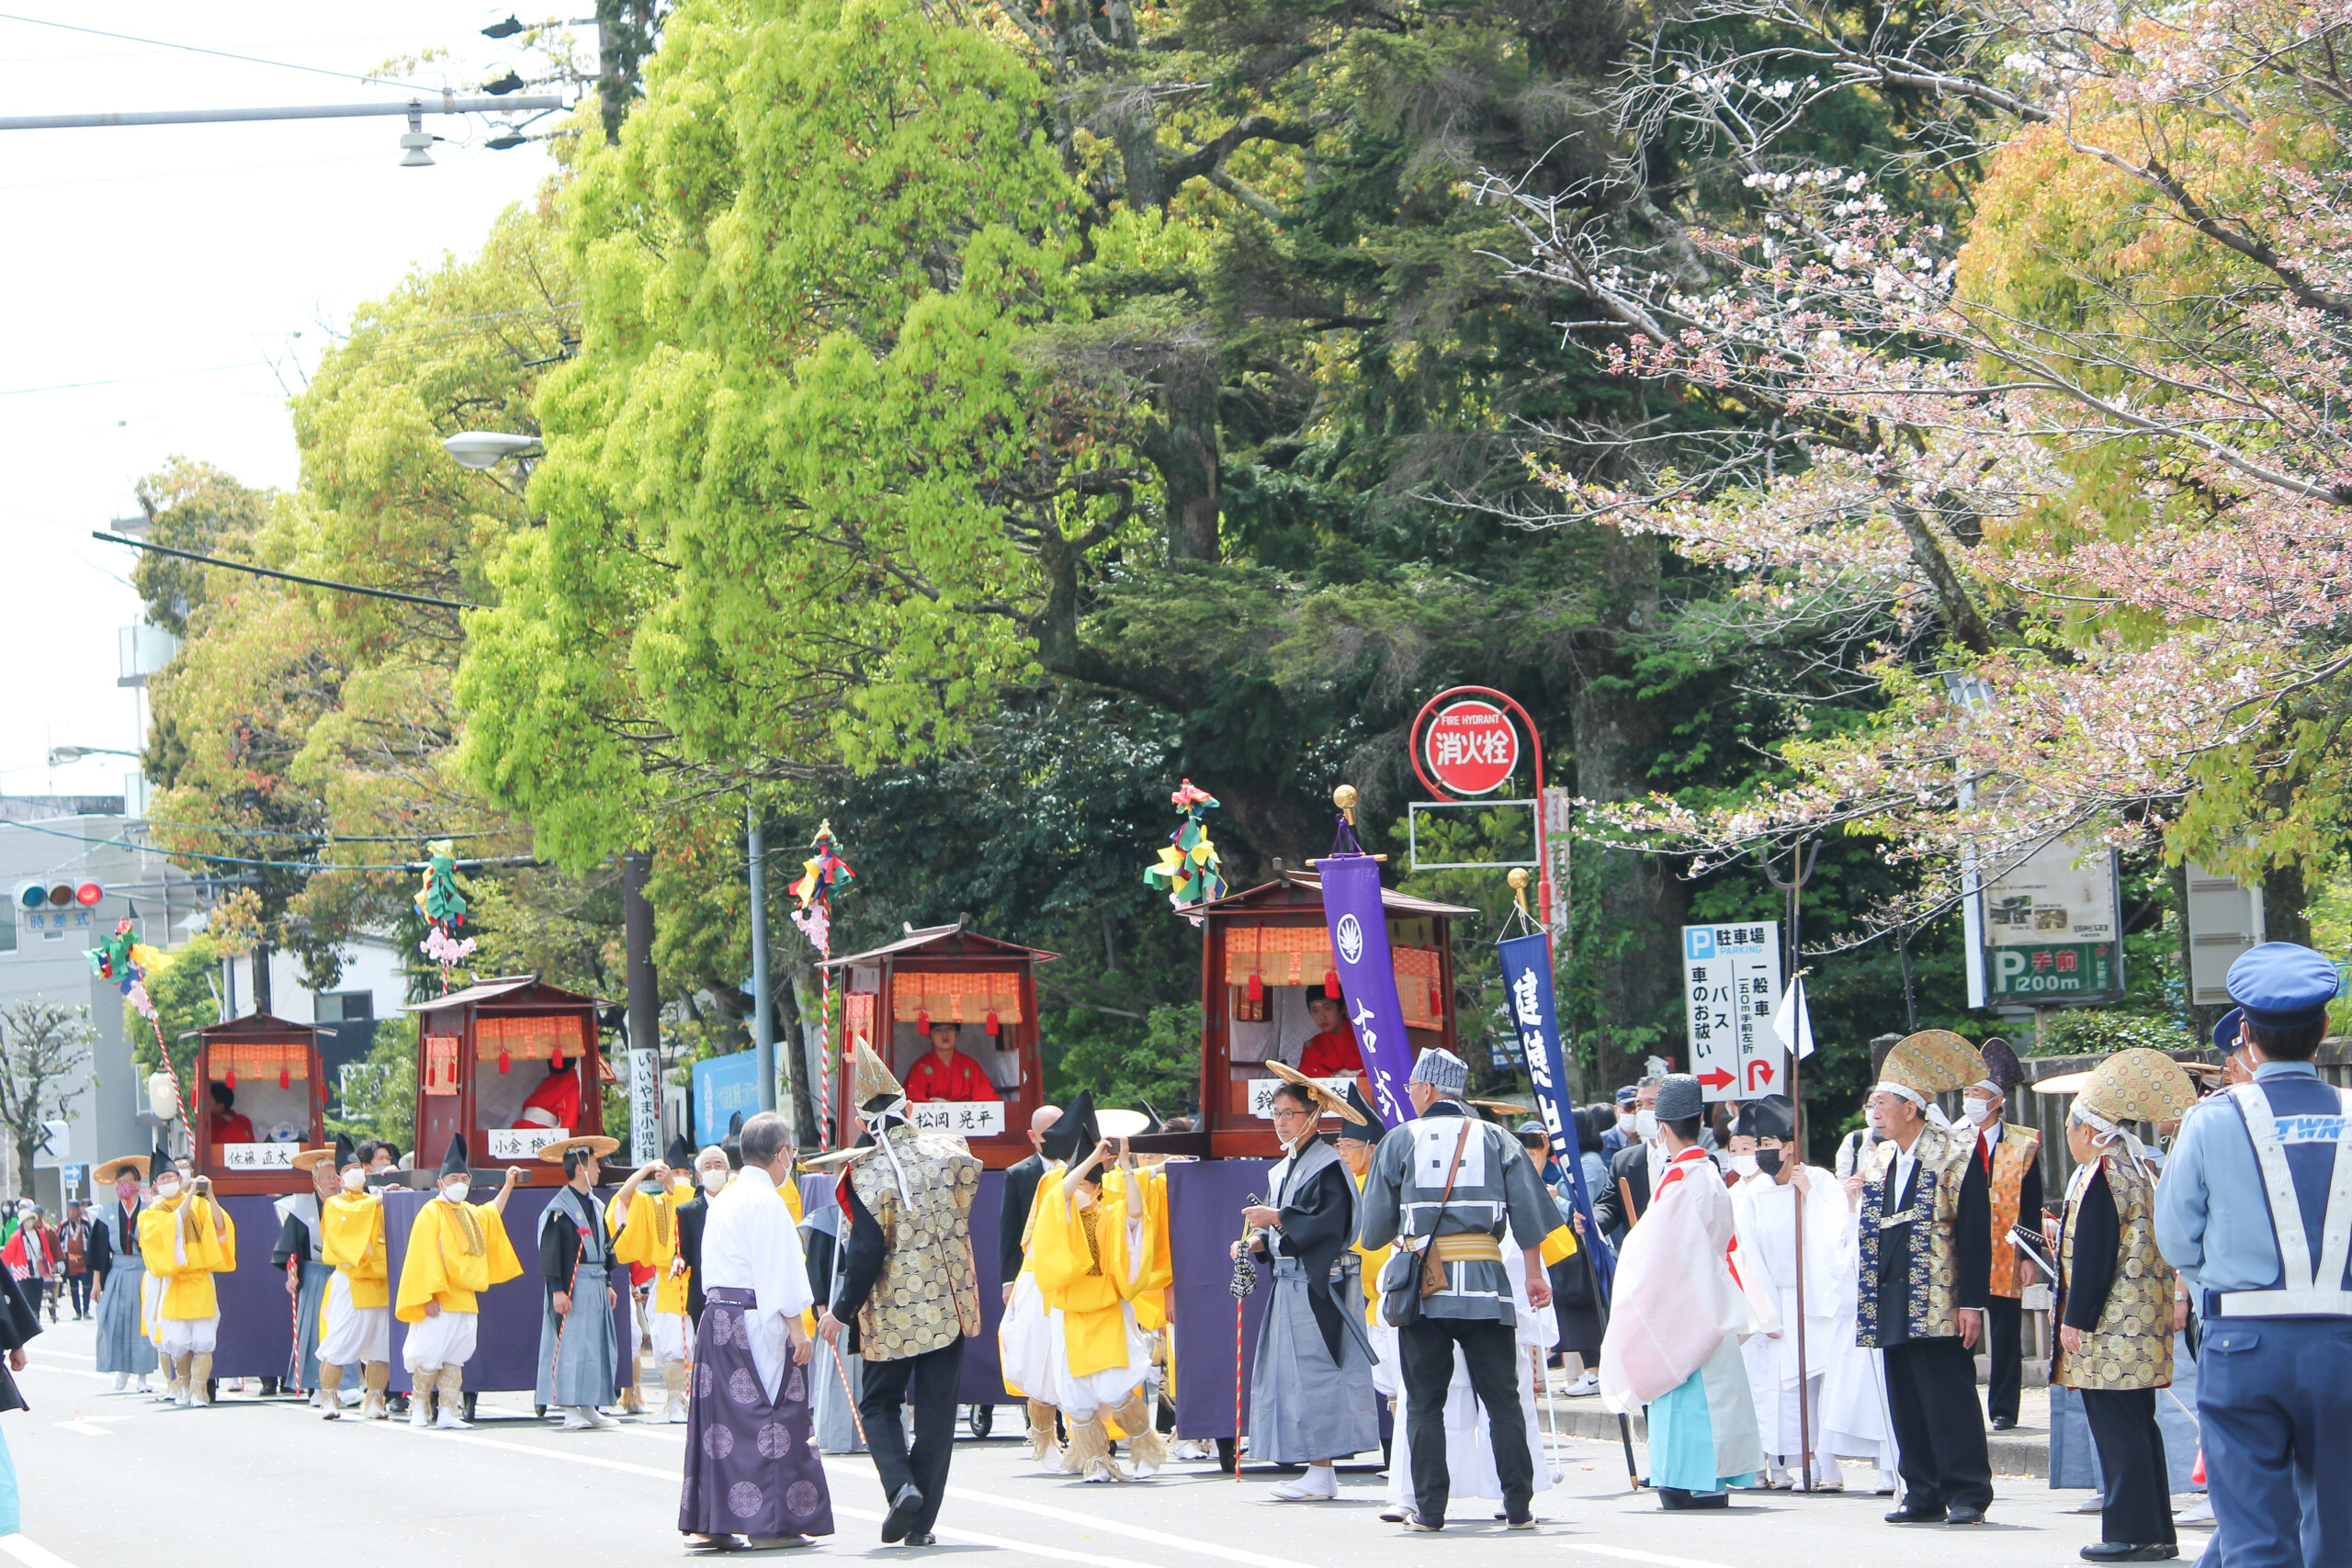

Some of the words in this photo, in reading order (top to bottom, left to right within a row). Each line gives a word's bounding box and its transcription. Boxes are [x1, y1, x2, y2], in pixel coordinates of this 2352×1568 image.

[1441, 716, 1460, 726] FIRE
[1462, 714, 1499, 725] HYDRANT
[1435, 729, 1510, 766] 消火栓
[30, 912, 90, 929] 時差式
[1692, 931, 1711, 956] P
[1716, 928, 1765, 946] 駐車場
[1720, 945, 1763, 955] PARKING
[2031, 950, 2078, 972] 手前
[1994, 951, 2026, 992] P
[1751, 964, 1770, 1017] 一般車
[2018, 976, 2079, 991] 200m
[1691, 966, 1712, 1058] 車のお祓い
[1712, 986, 1729, 1029] バス
[638, 1052, 655, 1162] いいやま小児科
[915, 1111, 949, 1129] 松岡
[958, 1111, 993, 1129] 晃平
[2274, 1118, 2346, 1141] TWN
[228, 1150, 256, 1165] 佐藤
[263, 1149, 290, 1165] 直太
[495, 1138, 522, 1154] 小倉
